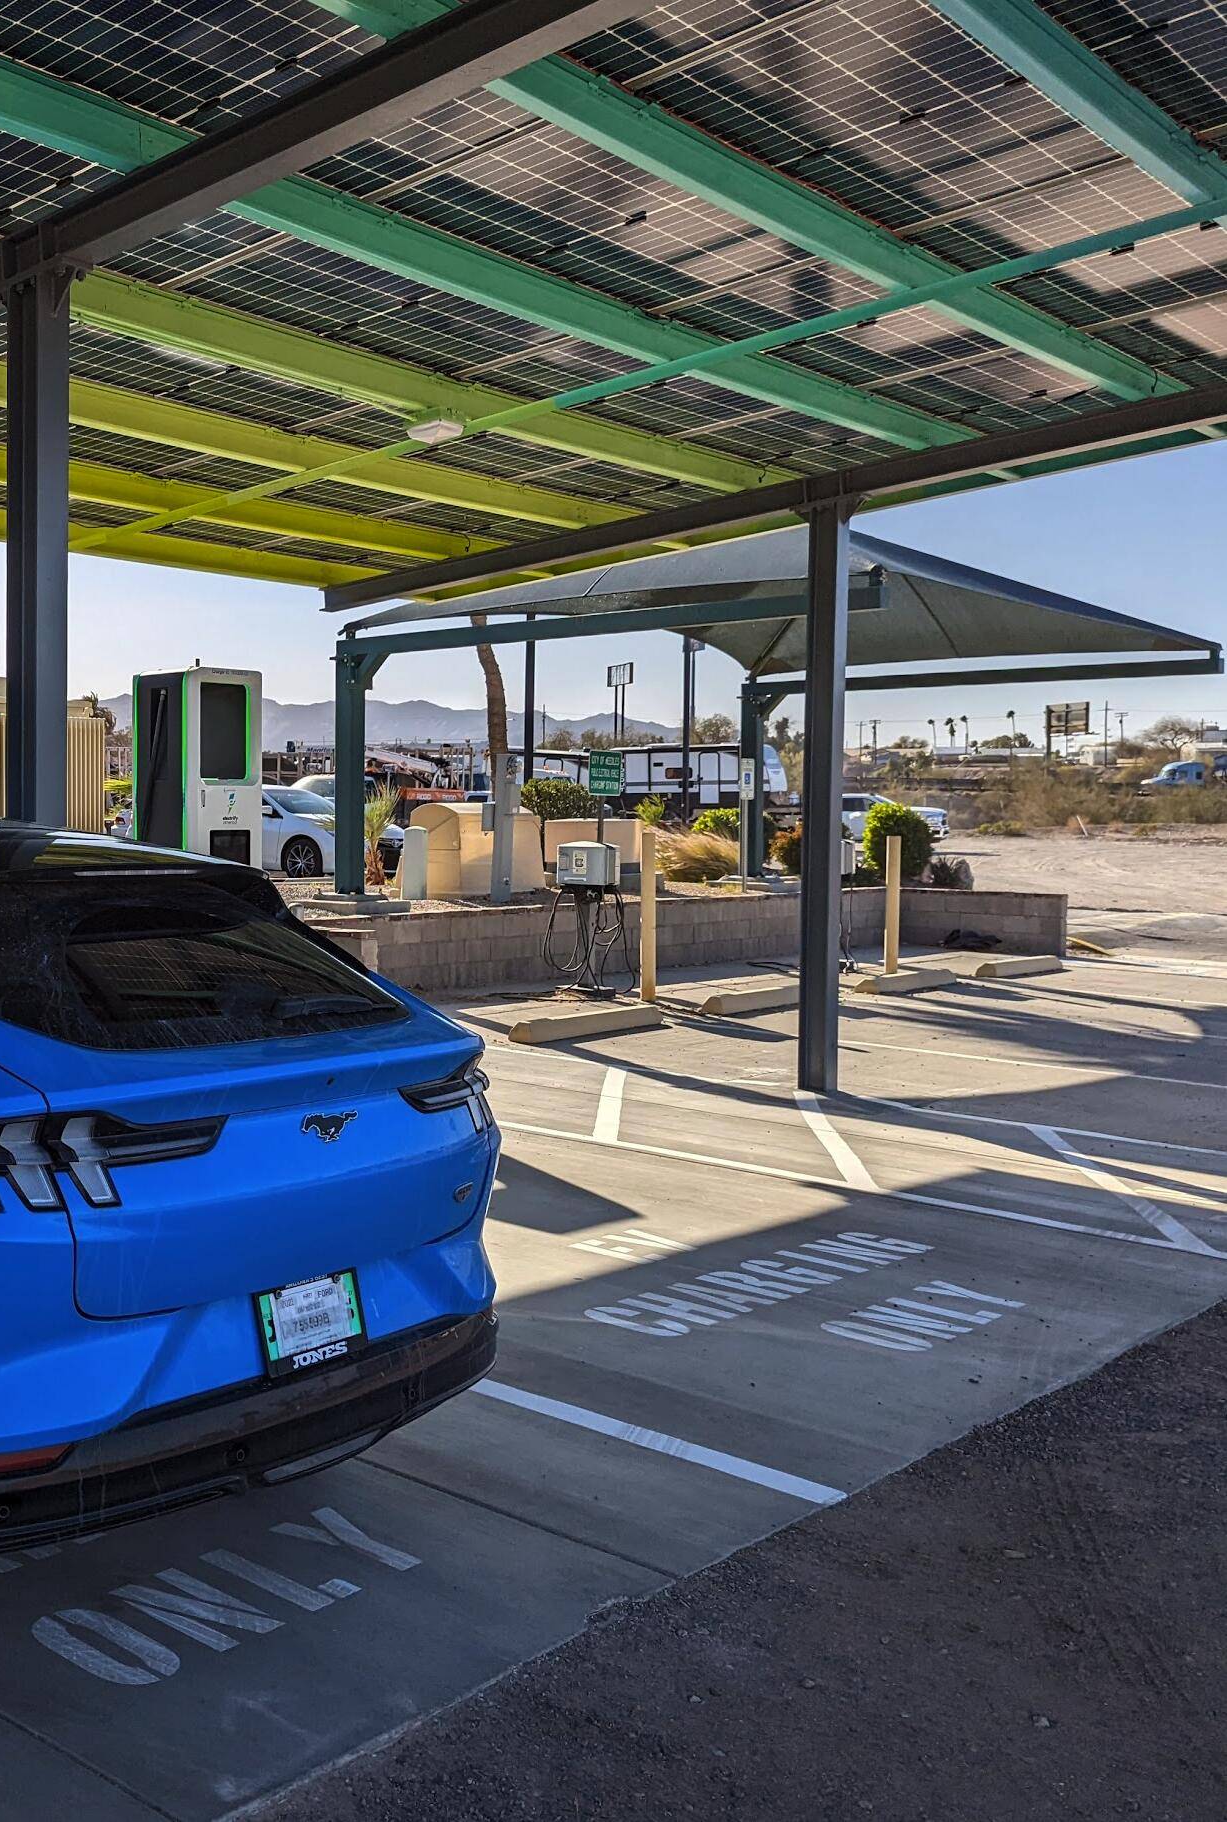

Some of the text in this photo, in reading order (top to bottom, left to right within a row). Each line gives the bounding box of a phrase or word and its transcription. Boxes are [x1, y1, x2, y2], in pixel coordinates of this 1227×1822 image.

[568, 1228, 697, 1265] EV
[317, 1287, 333, 1298] FORD
[584, 1231, 935, 1337] CHARGING
[820, 1280, 1027, 1352] ONLY
[292, 1340, 348, 1370] JONES
[30, 1505, 423, 1686] ONLY
